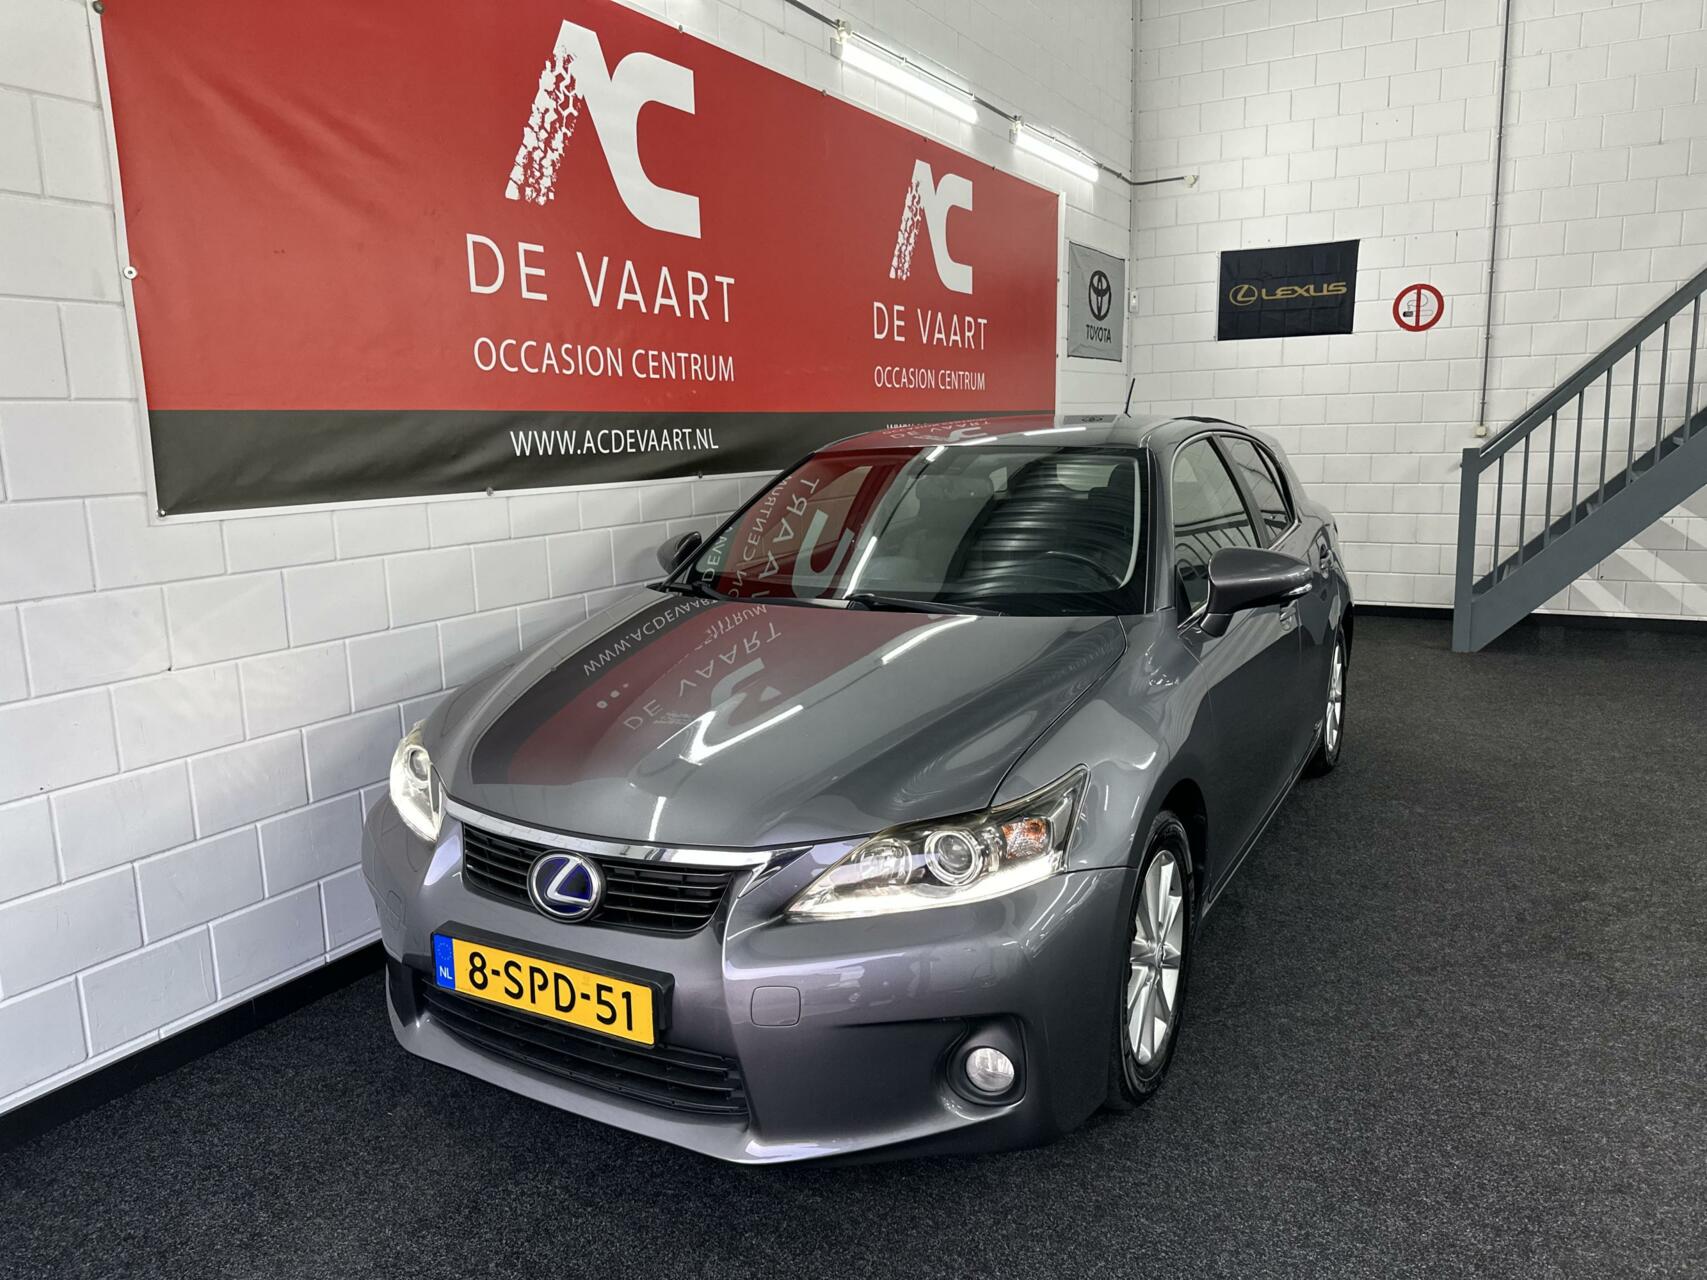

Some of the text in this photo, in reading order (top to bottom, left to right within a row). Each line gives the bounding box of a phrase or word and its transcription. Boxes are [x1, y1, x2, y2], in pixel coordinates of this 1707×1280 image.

[466, 233, 735, 323] DE VAART
[1261, 281, 1348, 301] LEXUS
[873, 301, 988, 350] DE VAART
[1085, 324, 1112, 344] TOYOTA
[473, 336, 735, 382] OCCASION CENTRUM
[874, 365, 986, 391] OCCASION CENTRUM
[509, 428, 719, 457] WWW.ACDEVAART.NL
[439, 965, 453, 980] NL
[468, 951, 634, 1032] 8-SPD-51
